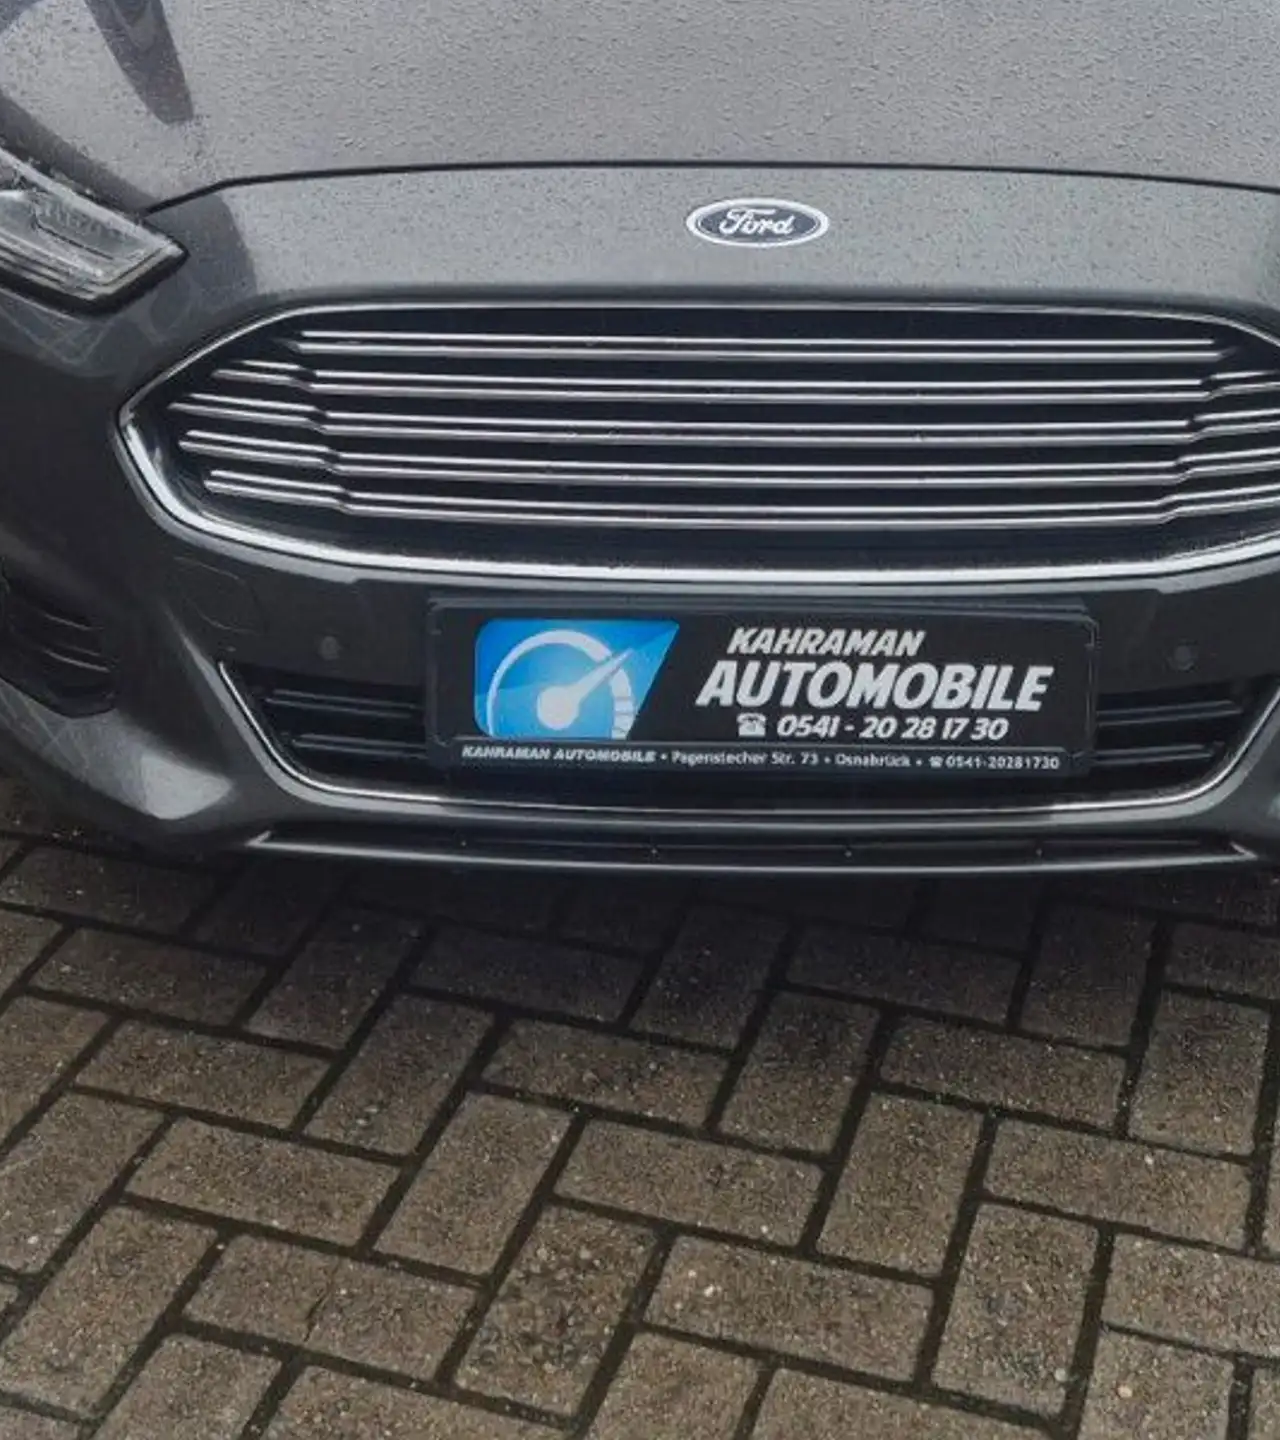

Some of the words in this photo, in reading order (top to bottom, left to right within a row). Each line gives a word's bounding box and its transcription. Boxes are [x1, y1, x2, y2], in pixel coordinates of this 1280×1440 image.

[719, 207, 796, 235] Ford
[727, 627, 926, 657] KAHRAMAN
[695, 660, 1054, 711] AUTOMOBILE
[776, 715, 840, 738] 0541
[859, 716, 898, 739] 20
[901, 717, 937, 740] 28
[941, 718, 970, 741] 17
[970, 717, 1010, 741] 30
[462, 745, 550, 760] KAHRAMAN
[553, 748, 656, 763] AUTOMOBILE
[672, 749, 768, 767] Pagenstecher
[800, 751, 819, 766] 73
[834, 752, 911, 767] Osnabrück
